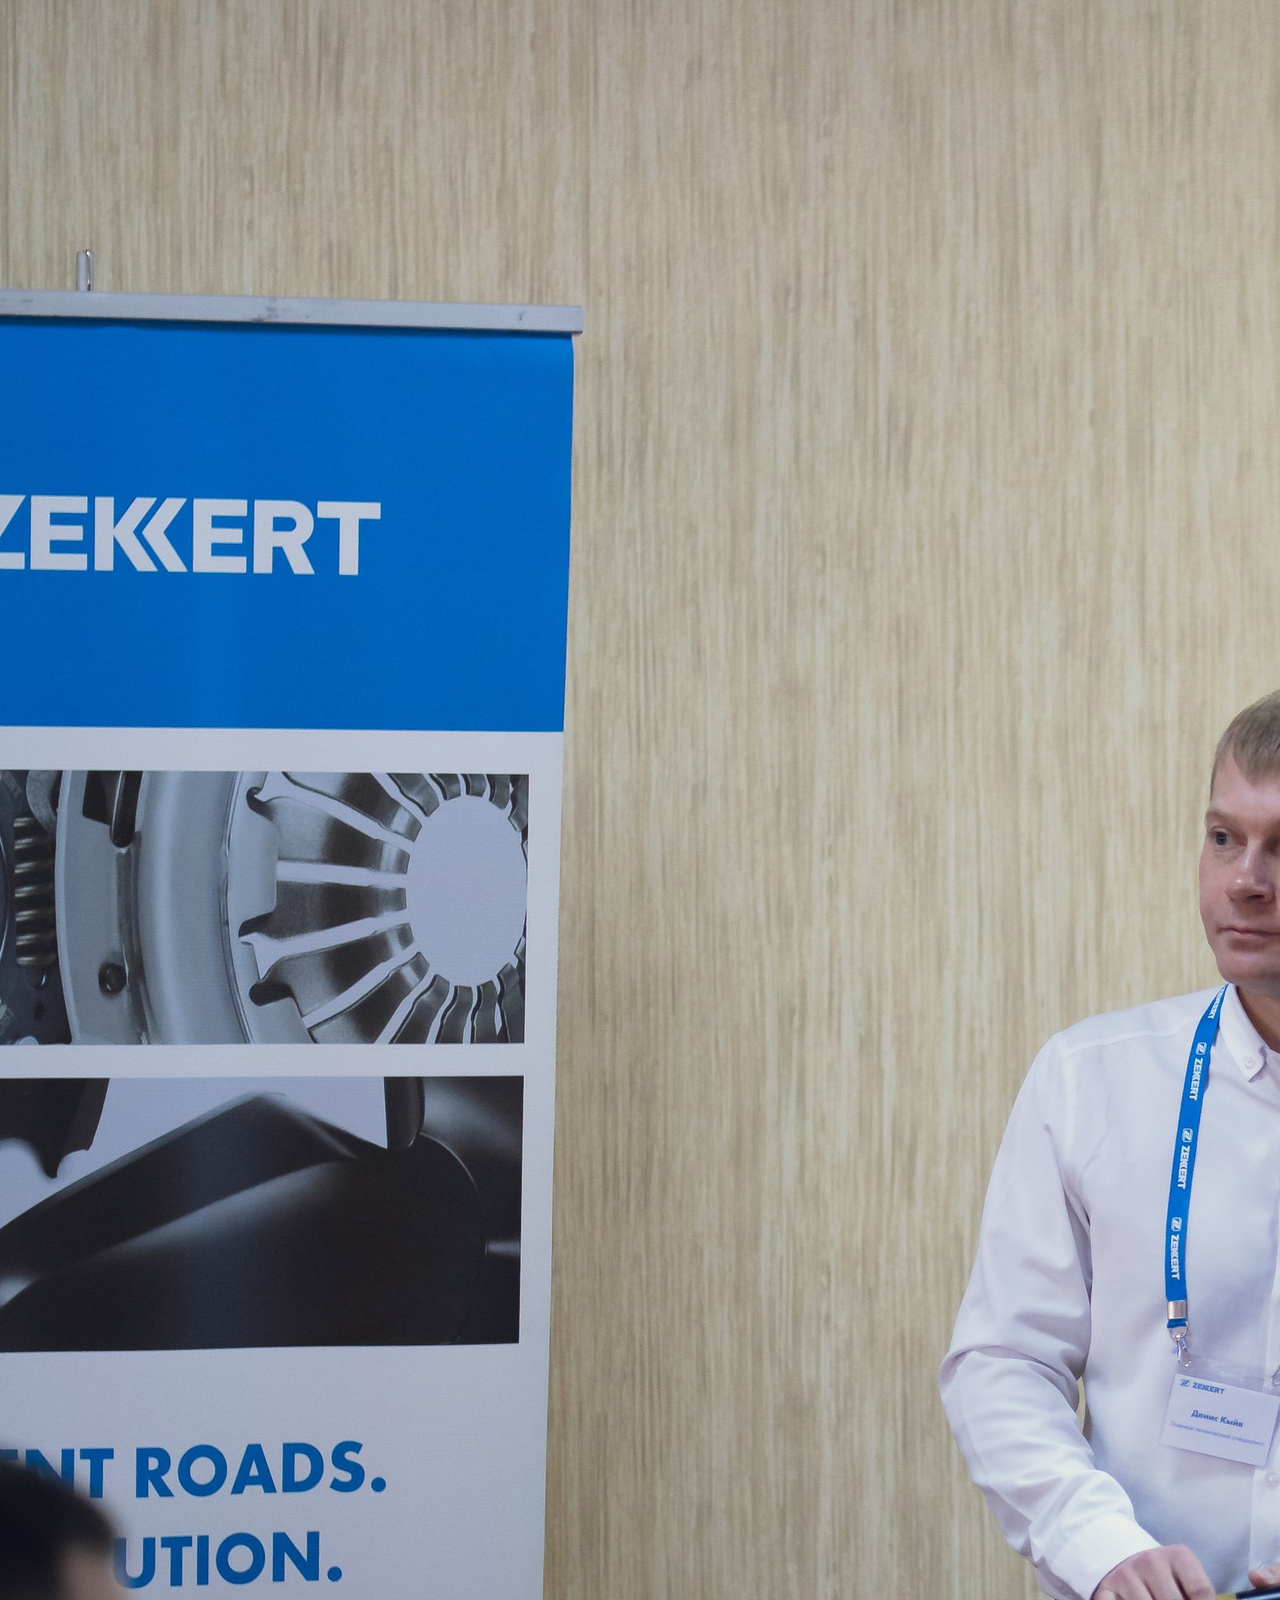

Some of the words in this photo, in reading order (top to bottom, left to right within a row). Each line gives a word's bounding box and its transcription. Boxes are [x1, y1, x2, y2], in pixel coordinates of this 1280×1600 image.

[1189, 1058, 1203, 1101] ZEKKERT
[1177, 1145, 1190, 1190] ZEKKERT
[1170, 1234, 1180, 1280] ZEKKERT
[1192, 1381, 1225, 1395] ZEKKERT
[1191, 1409, 1218, 1422] Денис
[136, 1441, 387, 1498] ROADS.
